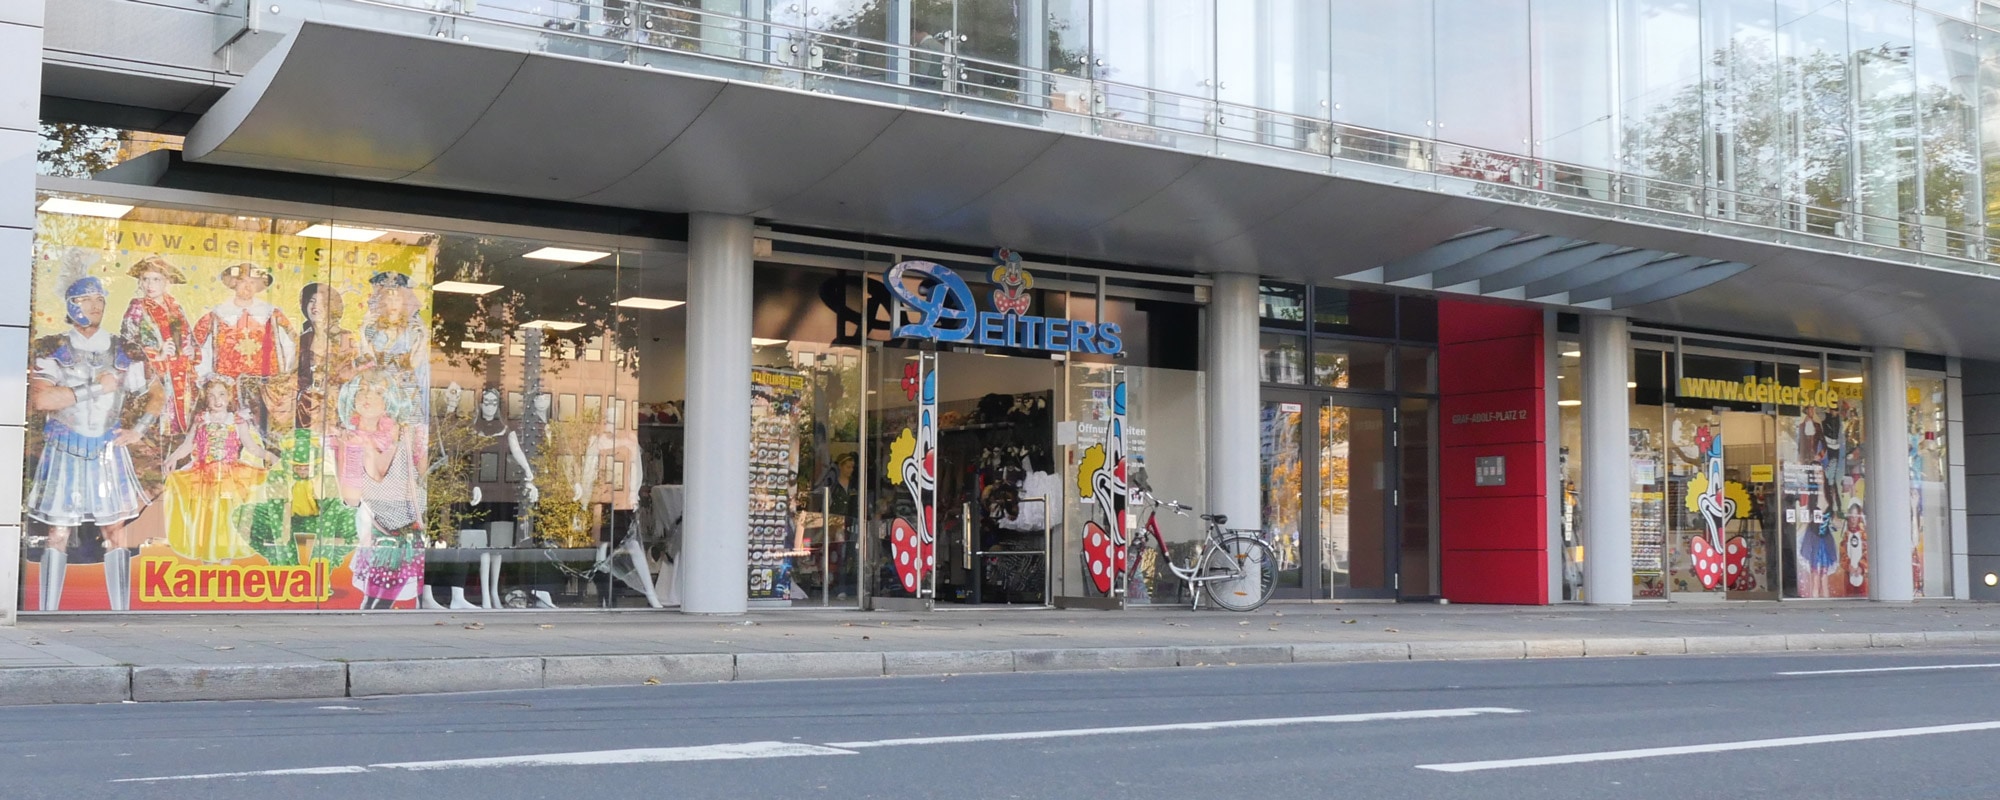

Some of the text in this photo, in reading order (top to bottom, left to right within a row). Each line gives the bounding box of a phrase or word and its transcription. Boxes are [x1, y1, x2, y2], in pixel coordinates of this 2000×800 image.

[105, 230, 379, 266] www.deiters.de
[1681, 375, 1838, 408] www.deiters.de
[1452, 409, 1527, 424] GRAF-ADOLF-PLATZ 12
[145, 560, 324, 597] Karneval
